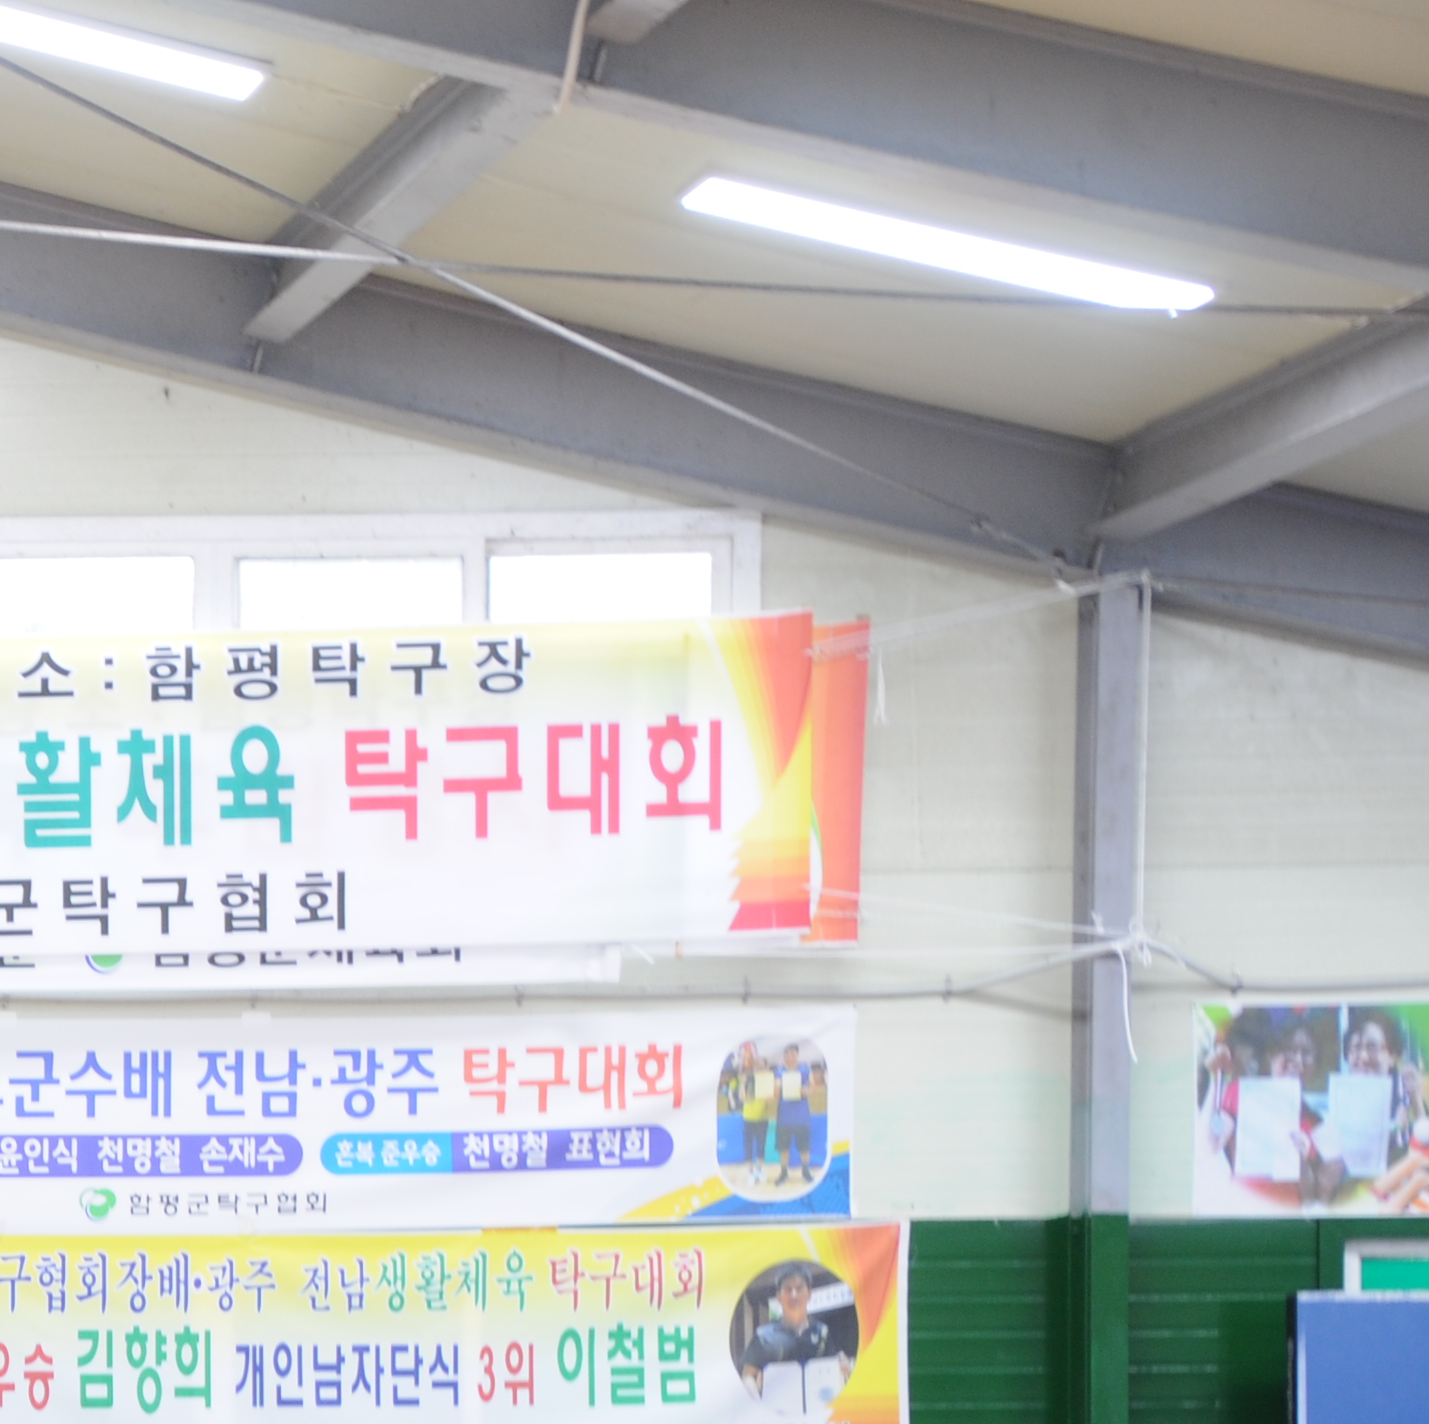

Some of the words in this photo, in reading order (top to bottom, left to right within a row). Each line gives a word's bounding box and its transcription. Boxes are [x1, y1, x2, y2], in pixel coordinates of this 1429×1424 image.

[145, 636, 532, 704] 함평탁구장
[343, 713, 725, 841] 탁구대회
[196, 1047, 440, 1119] 전남·광주
[461, 1041, 686, 1115] 탁구대회
[96, 1135, 182, 1175] 천명철
[198, 1136, 286, 1173] 손재수
[381, 1138, 442, 1167] 준우승
[463, 1131, 549, 1169] 천명철
[128, 1190, 328, 1216] 함평군탁구협회
[548, 1246, 707, 1313] 탁구대회
[76, 1324, 213, 1414] 김향희
[234, 1340, 461, 1409] 개인남자단식
[477, 1339, 536, 1408] 3위
[556, 1322, 699, 1408] 이철범
